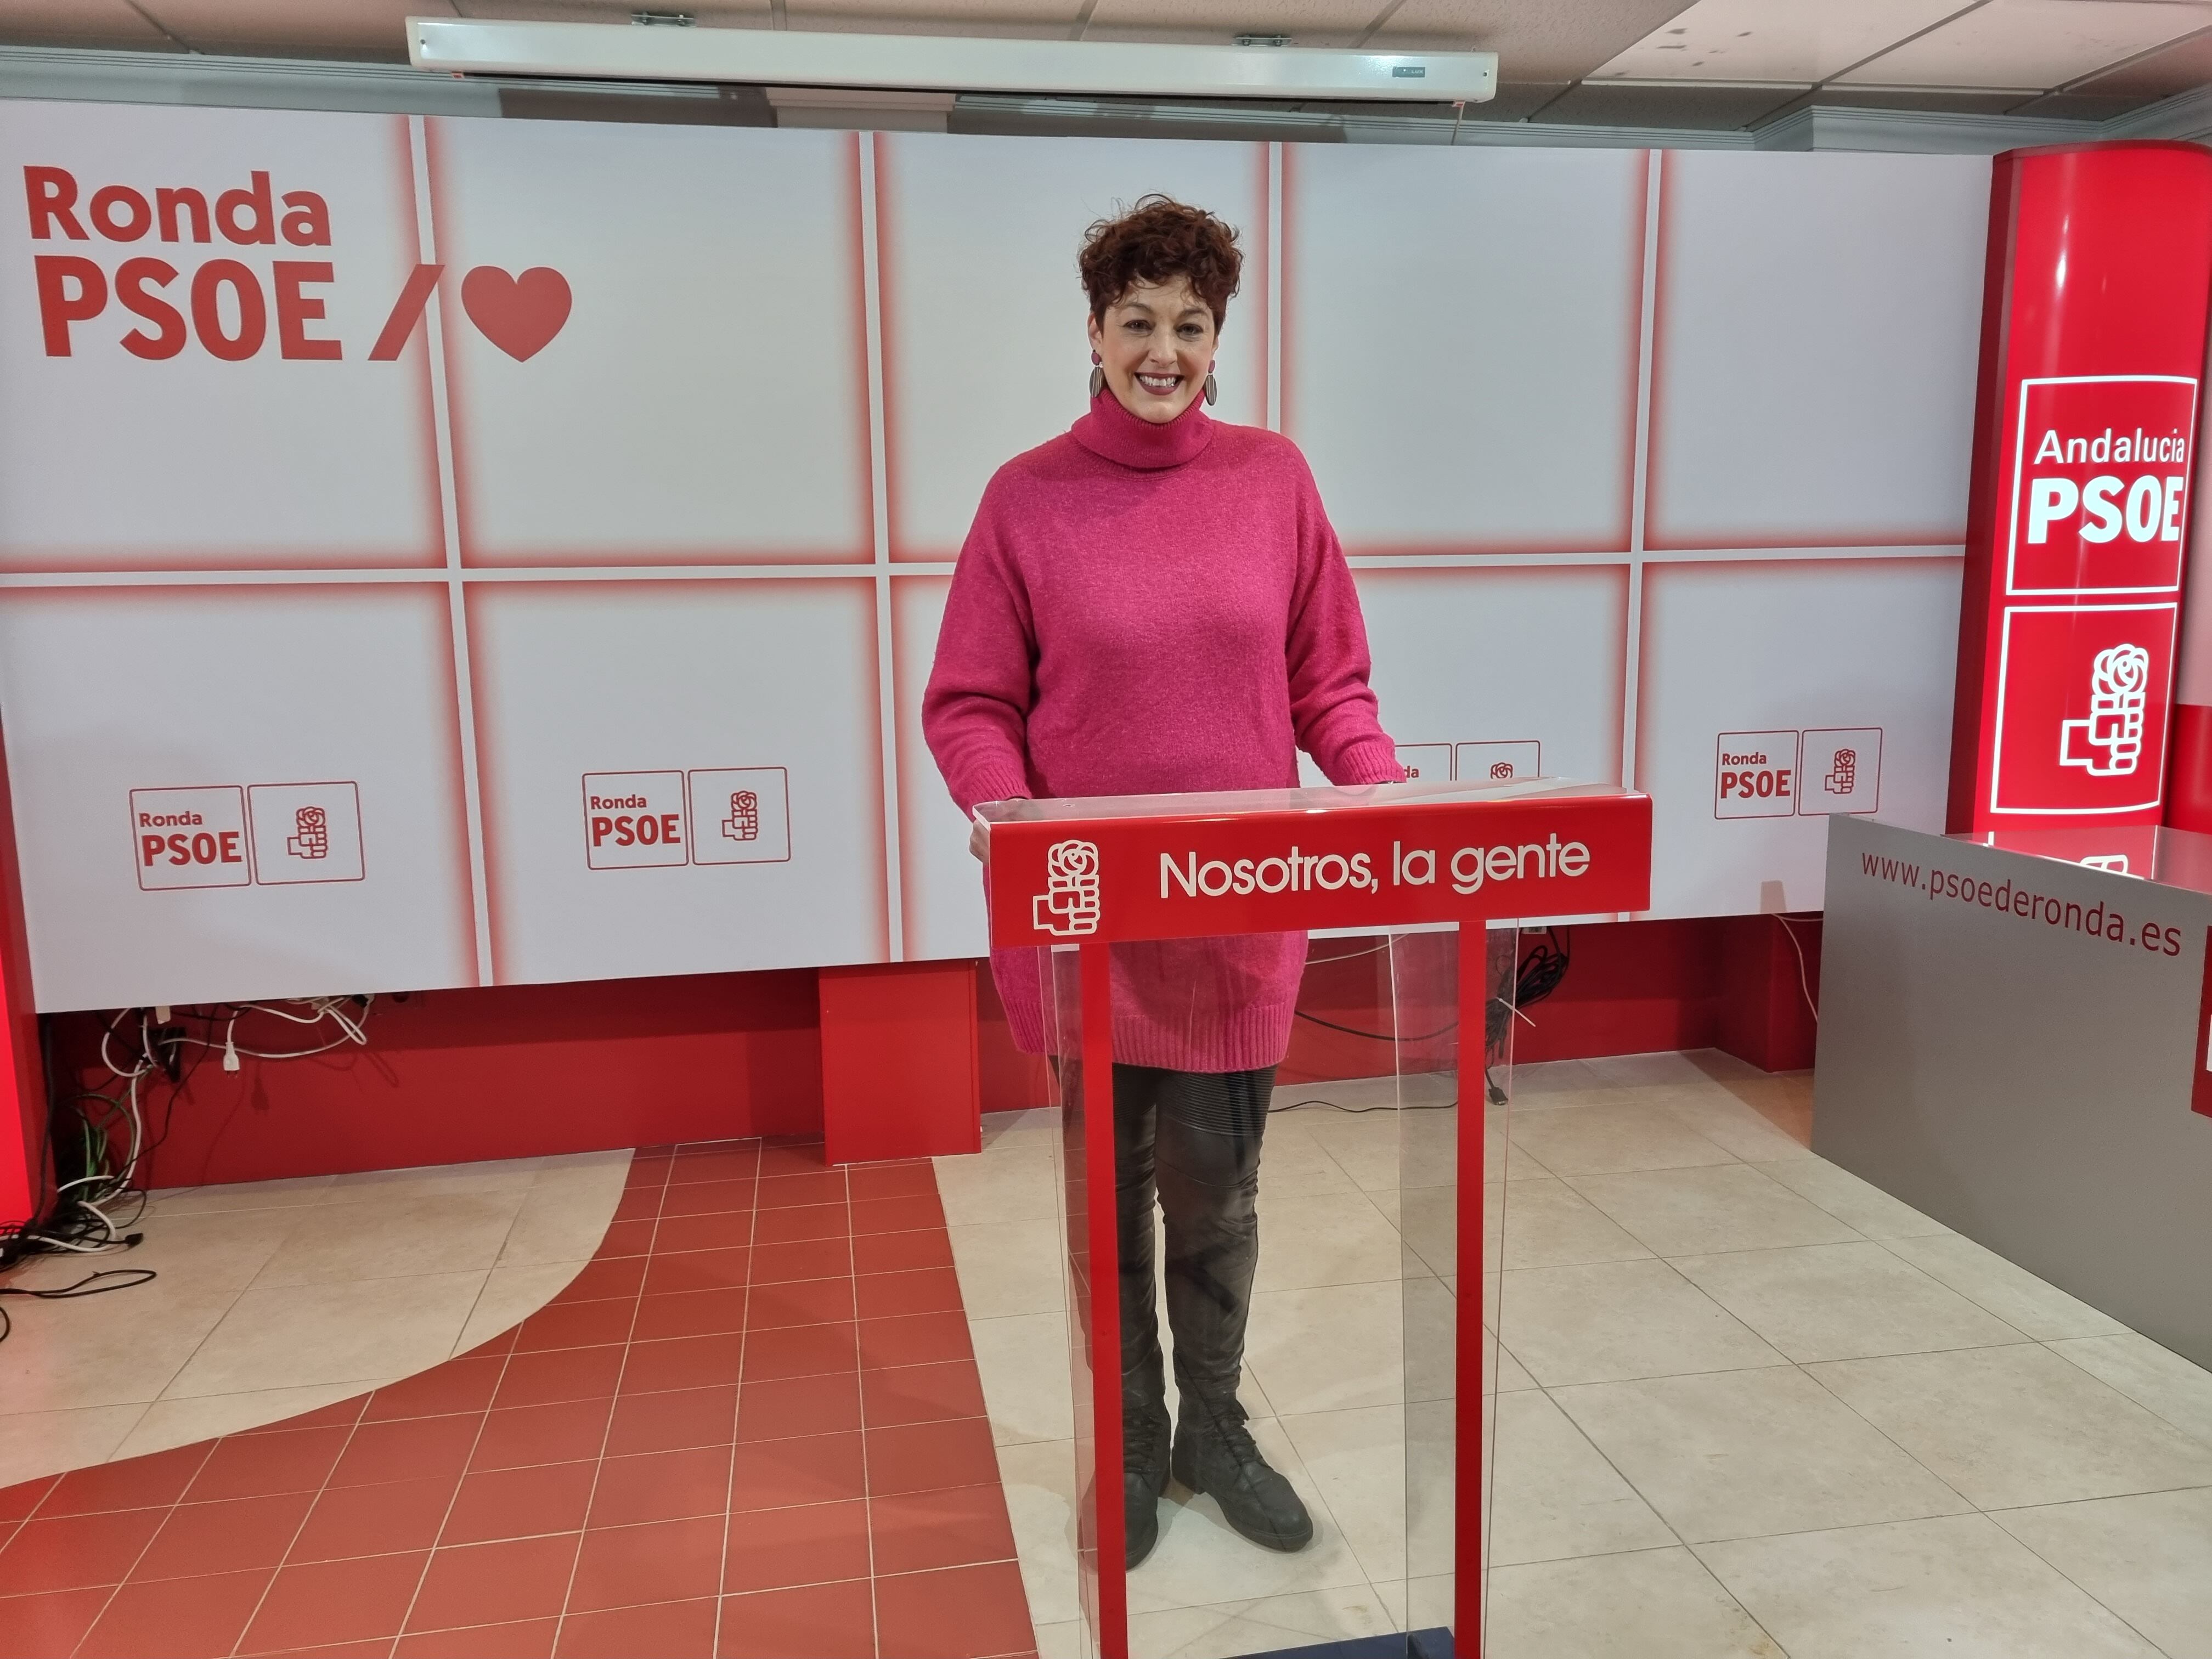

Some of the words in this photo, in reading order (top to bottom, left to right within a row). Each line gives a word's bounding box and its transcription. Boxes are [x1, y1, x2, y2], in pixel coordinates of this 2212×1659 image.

[23, 166, 331, 246] Ronda
[34, 255, 343, 362] PSOE
[2027, 475, 2184, 544] PSOE
[1721, 752, 1767, 766] Ronda
[590, 794, 647, 810] Ronda
[1720, 769, 1792, 799] PSOE
[138, 810, 203, 827] Ronda
[591, 814, 681, 847] PSOE
[141, 831, 242, 867] PSOE
[1160, 845, 1379, 899] Nosotros,
[1393, 840, 1436, 886] la
[1451, 833, 1590, 895] gente
[1861, 852, 2181, 957] www.psoederonda.es
